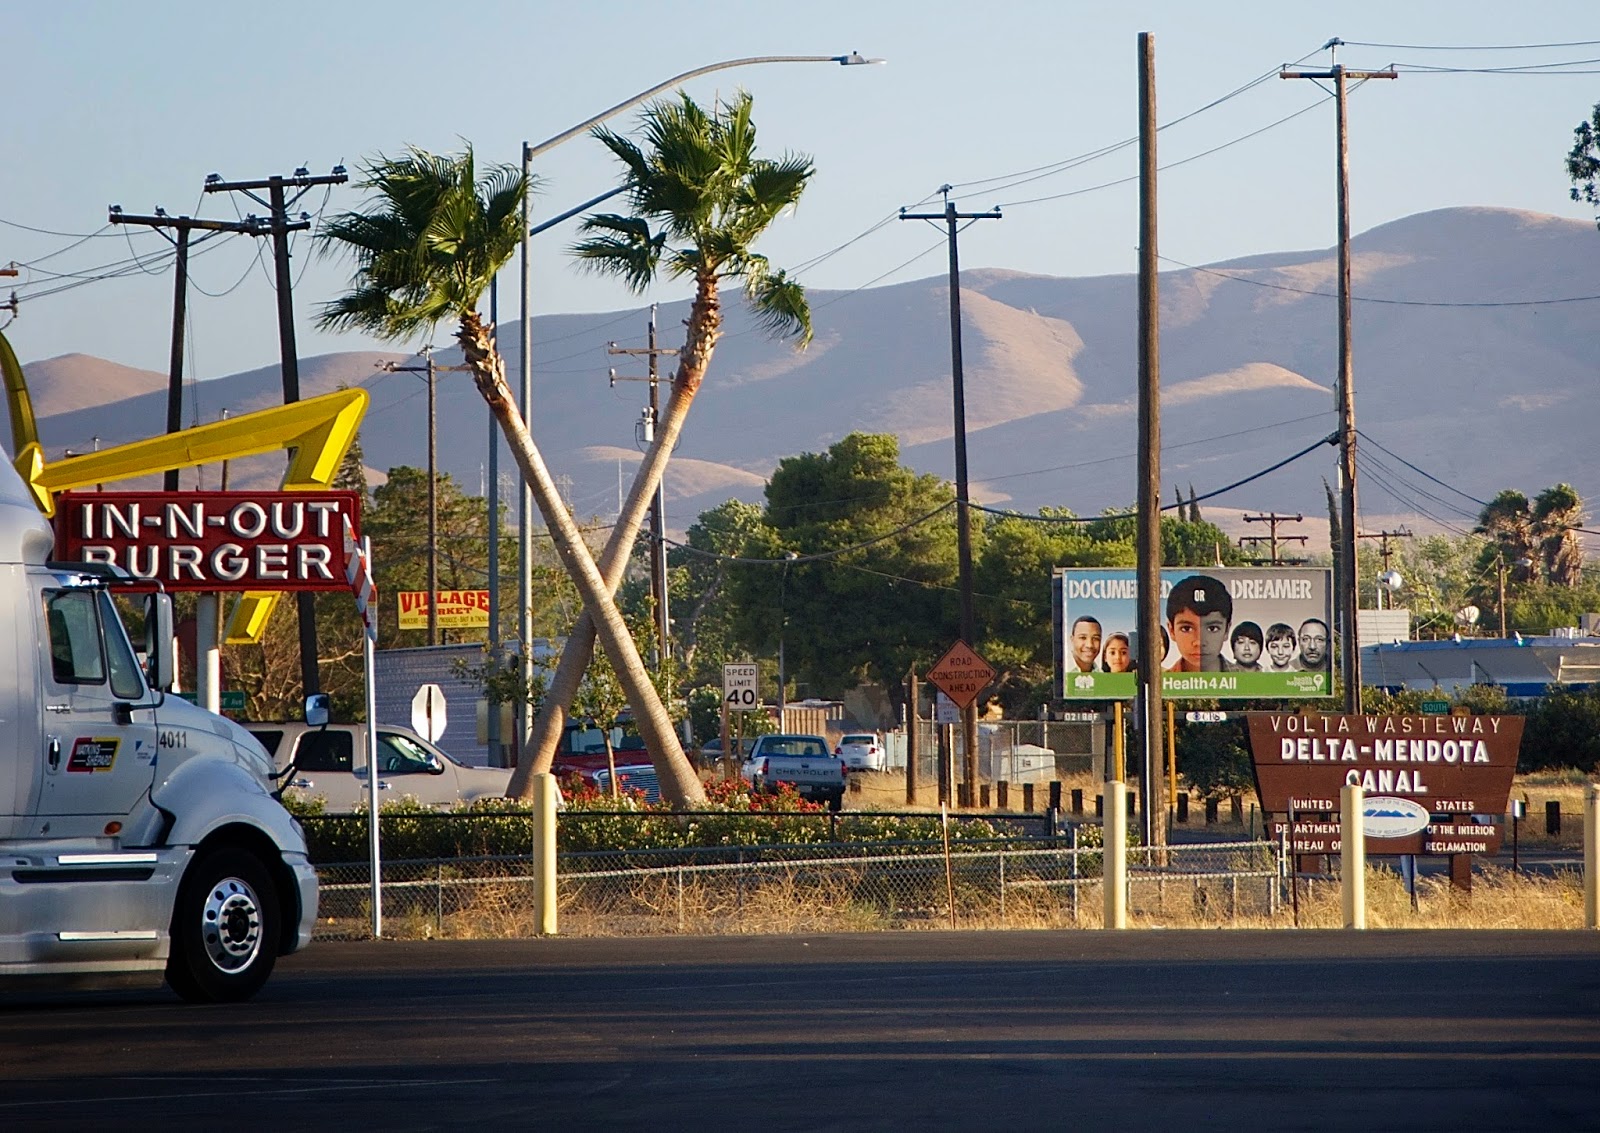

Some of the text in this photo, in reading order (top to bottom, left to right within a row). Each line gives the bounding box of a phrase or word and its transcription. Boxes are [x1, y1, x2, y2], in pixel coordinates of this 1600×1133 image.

[82, 502, 339, 539] IN-N-OUT
[1231, 579, 1312, 599] DREAMER
[1194, 590, 1205, 602] OR
[418, 607, 472, 616] MRKET
[950, 657, 972, 666] ROAD
[726, 668, 755, 676] SPEED
[932, 669, 991, 680] CONSTRUCTION
[729, 679, 752, 687] LIMIT
[949, 683, 976, 693] AHEAD
[1162, 677, 1237, 690] Health 4 All
[726, 689, 755, 705] 40
[1424, 703, 1447, 712] SOUTH
[1271, 716, 1500, 734] VOLTA WASTEWAY
[160, 731, 187, 748] 4011
[1281, 737, 1489, 762] DELTA-MENDOTA
[776, 768, 834, 776] CHEVROLET
[1346, 769, 1428, 792] CANAL
[1293, 799, 1475, 811] UNITED STATES
[1275, 823, 1495, 836] DEARTMENT OF THE INTERIOR
[1425, 842, 1487, 852] RECLAMATION
